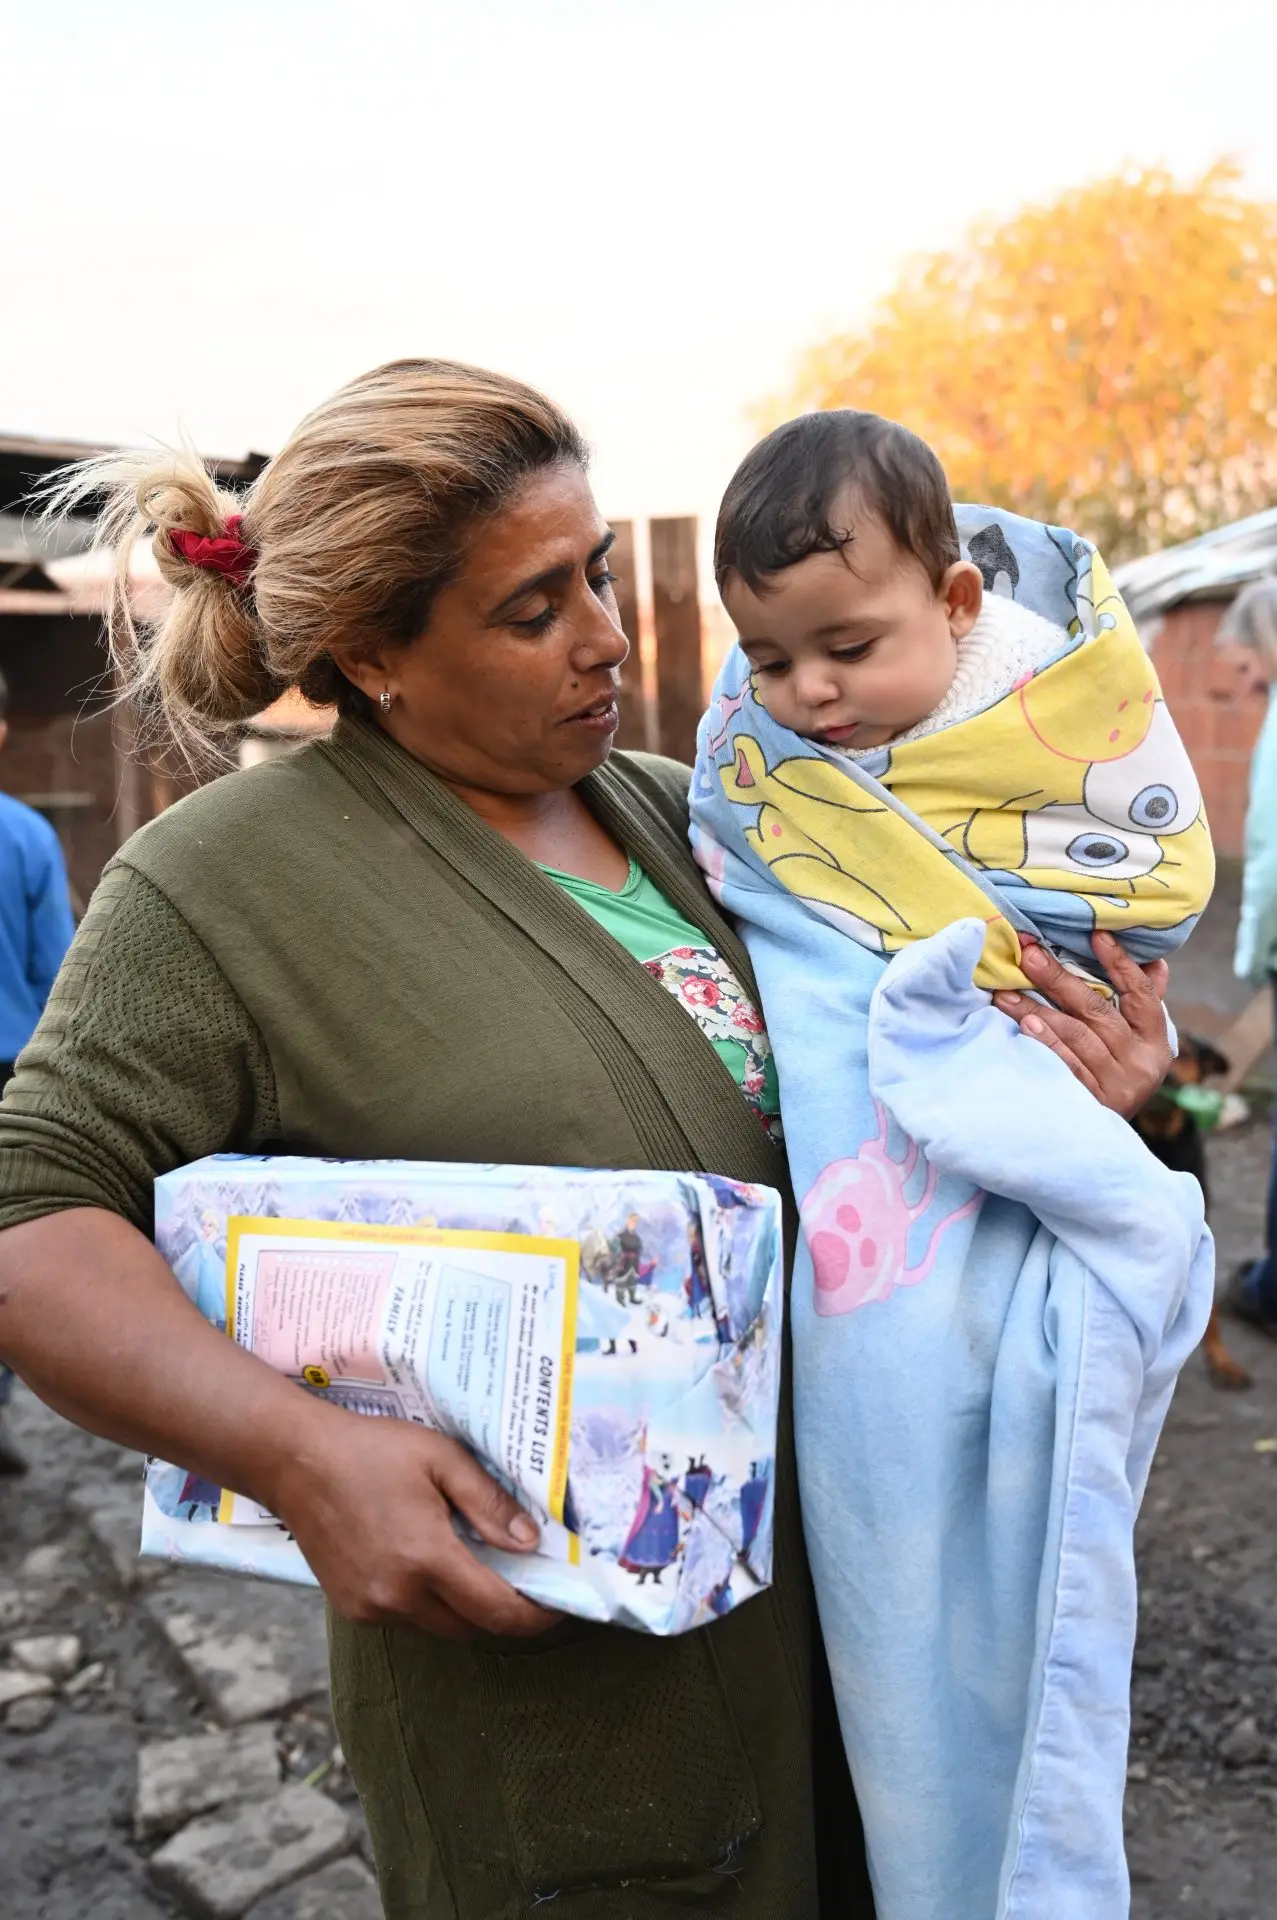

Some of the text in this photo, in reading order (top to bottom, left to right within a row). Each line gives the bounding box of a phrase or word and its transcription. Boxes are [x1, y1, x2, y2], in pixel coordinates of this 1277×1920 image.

[386, 1286, 406, 1336] FAMILY
[529, 1355, 554, 1475] CONTENTS LIST
